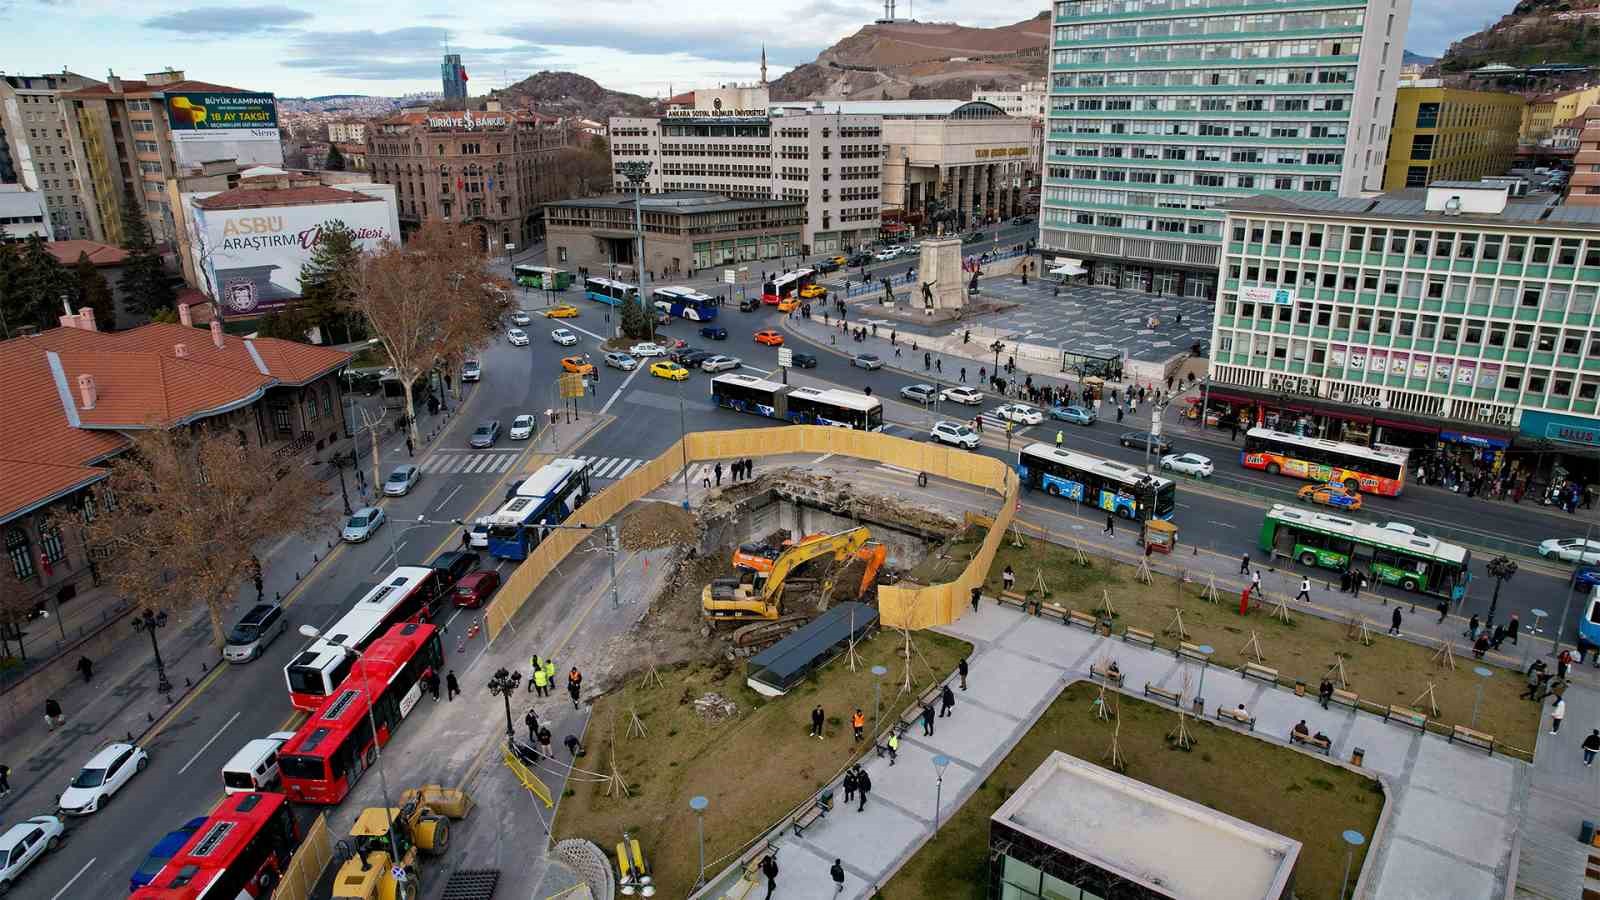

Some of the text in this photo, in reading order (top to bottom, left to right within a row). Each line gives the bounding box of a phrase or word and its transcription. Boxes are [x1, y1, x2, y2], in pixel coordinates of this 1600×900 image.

[204, 95, 273, 105] BÜYÜK KAMPANYA
[223, 112, 236, 121] AY
[239, 111, 270, 121] TAKSİT
[429, 116, 463, 127] TÜRKİYE
[223, 215, 283, 235] ASBÜ
